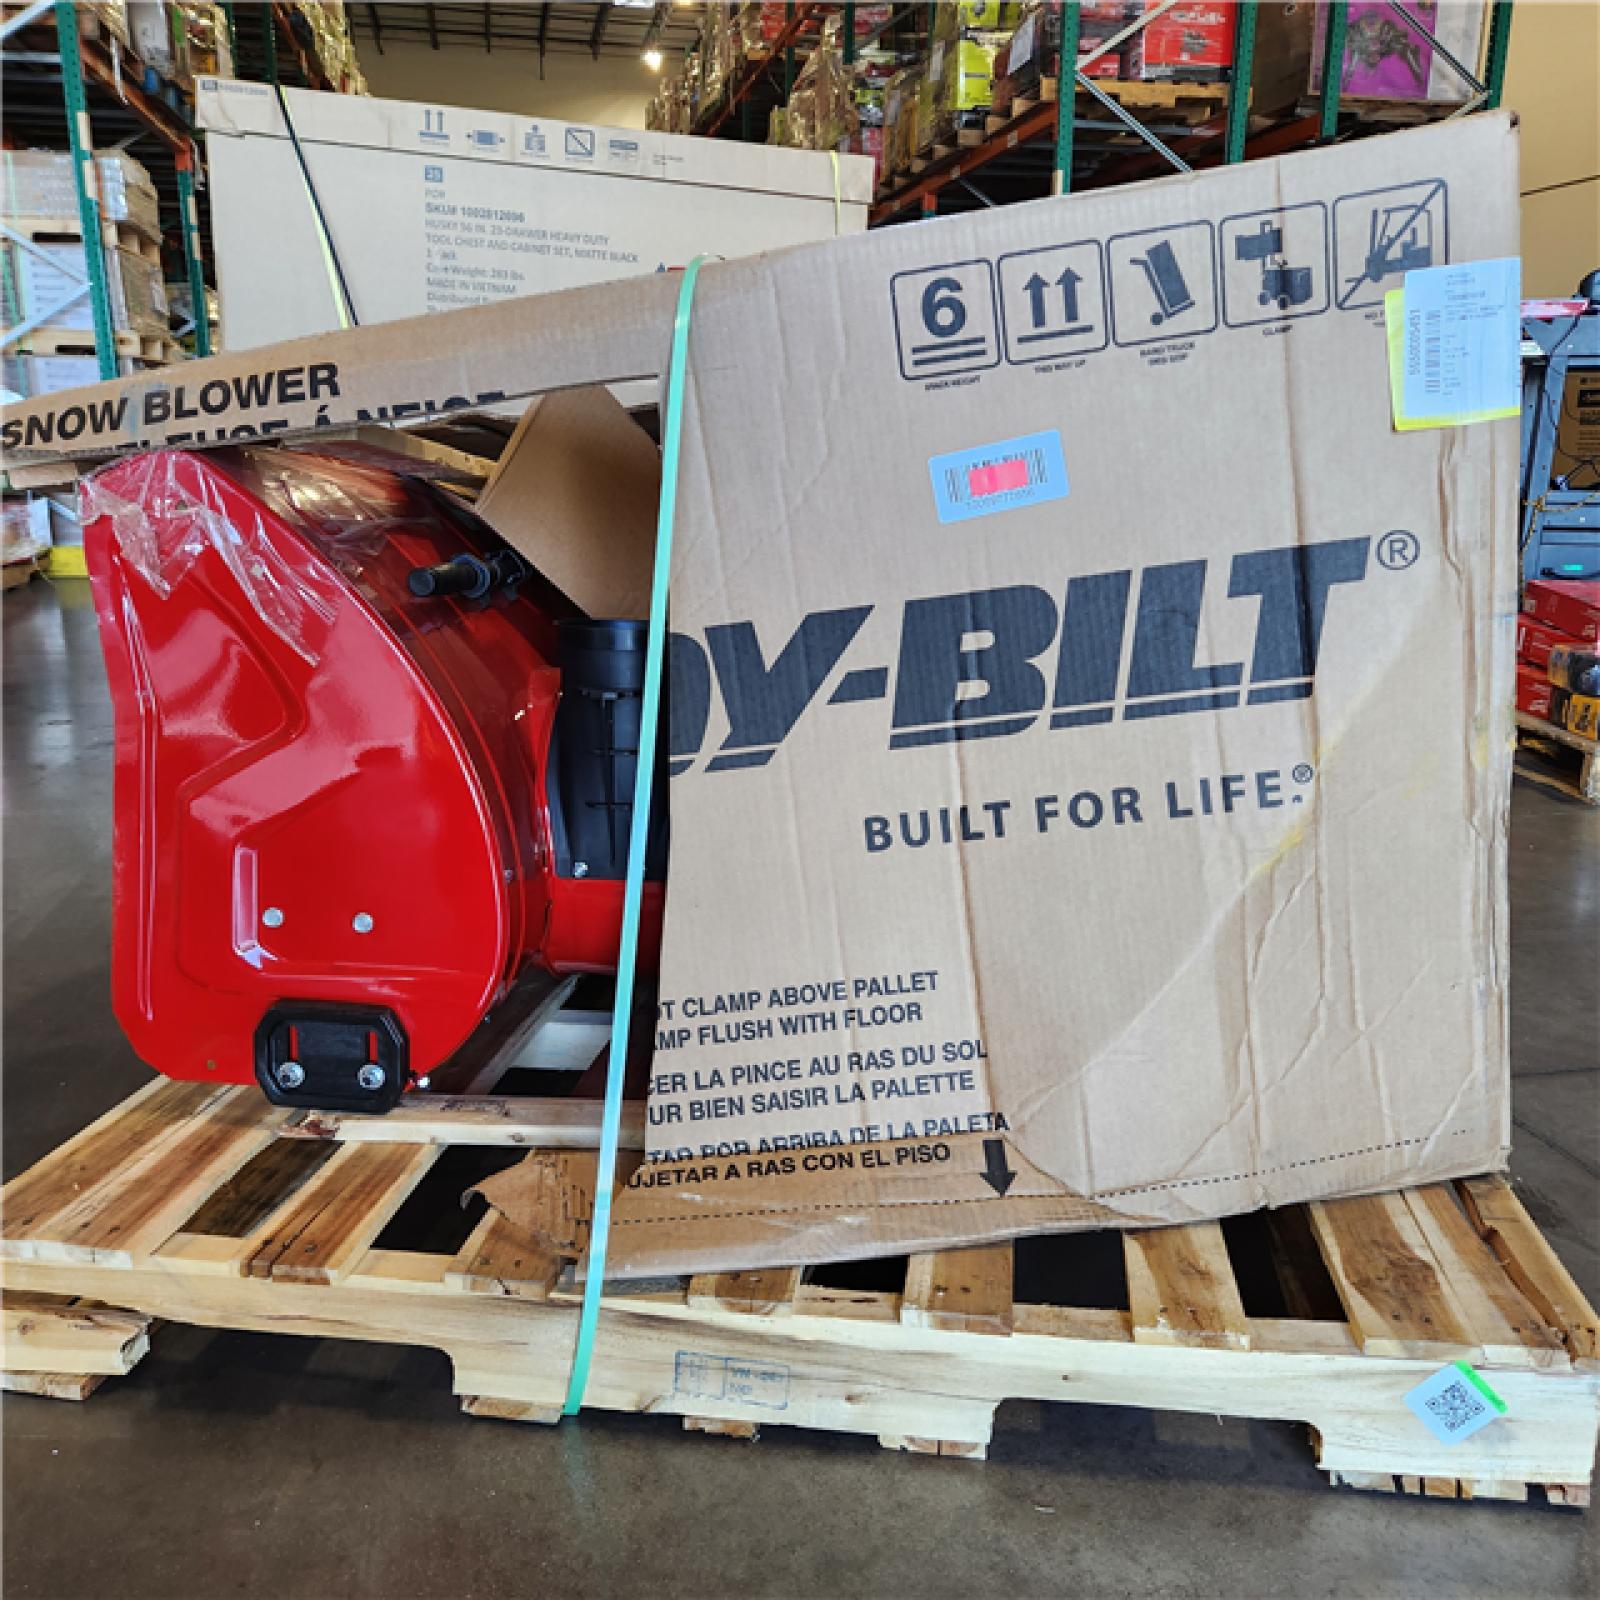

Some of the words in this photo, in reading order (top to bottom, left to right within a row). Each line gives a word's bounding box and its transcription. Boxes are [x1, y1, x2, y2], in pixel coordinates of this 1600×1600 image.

[425, 233, 453, 246] TOOL
[455, 235, 485, 249] CHEST
[509, 240, 551, 256] CABINET
[609, 250, 639, 264] BLACK
[921, 276, 968, 339] 6
[1, 396, 129, 450] SNOW
[143, 362, 342, 426] BLOWER
[863, 799, 1011, 853] BUILT
[1035, 786, 1143, 834] FOR
[682, 989, 762, 1019] CLAMP
[767, 980, 847, 1009] ABOVE
[853, 969, 939, 998] PALLET
[698, 1018, 774, 1046] FLUSH
[780, 1010, 837, 1037] WITH
[844, 1001, 922, 1029] FLOOR
[694, 1068, 726, 1090] LA
[730, 1058, 803, 1085] PINCE
[809, 1054, 840, 1077] AU
[846, 1047, 896, 1072] RAS
[902, 1043, 936, 1066] DU
[941, 1039, 988, 1061] SOL
[689, 1094, 745, 1121] BIEN
[751, 1085, 829, 1114] SAISIR
[835, 1081, 866, 1104] LA
[872, 1069, 976, 1101] PALETTE
[850, 1124, 880, 1145] DE
[887, 1120, 918, 1141] LA
[924, 1110, 1011, 1139] PALETA
[724, 1163, 741, 1181] A
[747, 1157, 796, 1178] RAS
[802, 1151, 854, 1172] CON
[861, 1148, 891, 1168] EL
[896, 1142, 951, 1166] PISO
